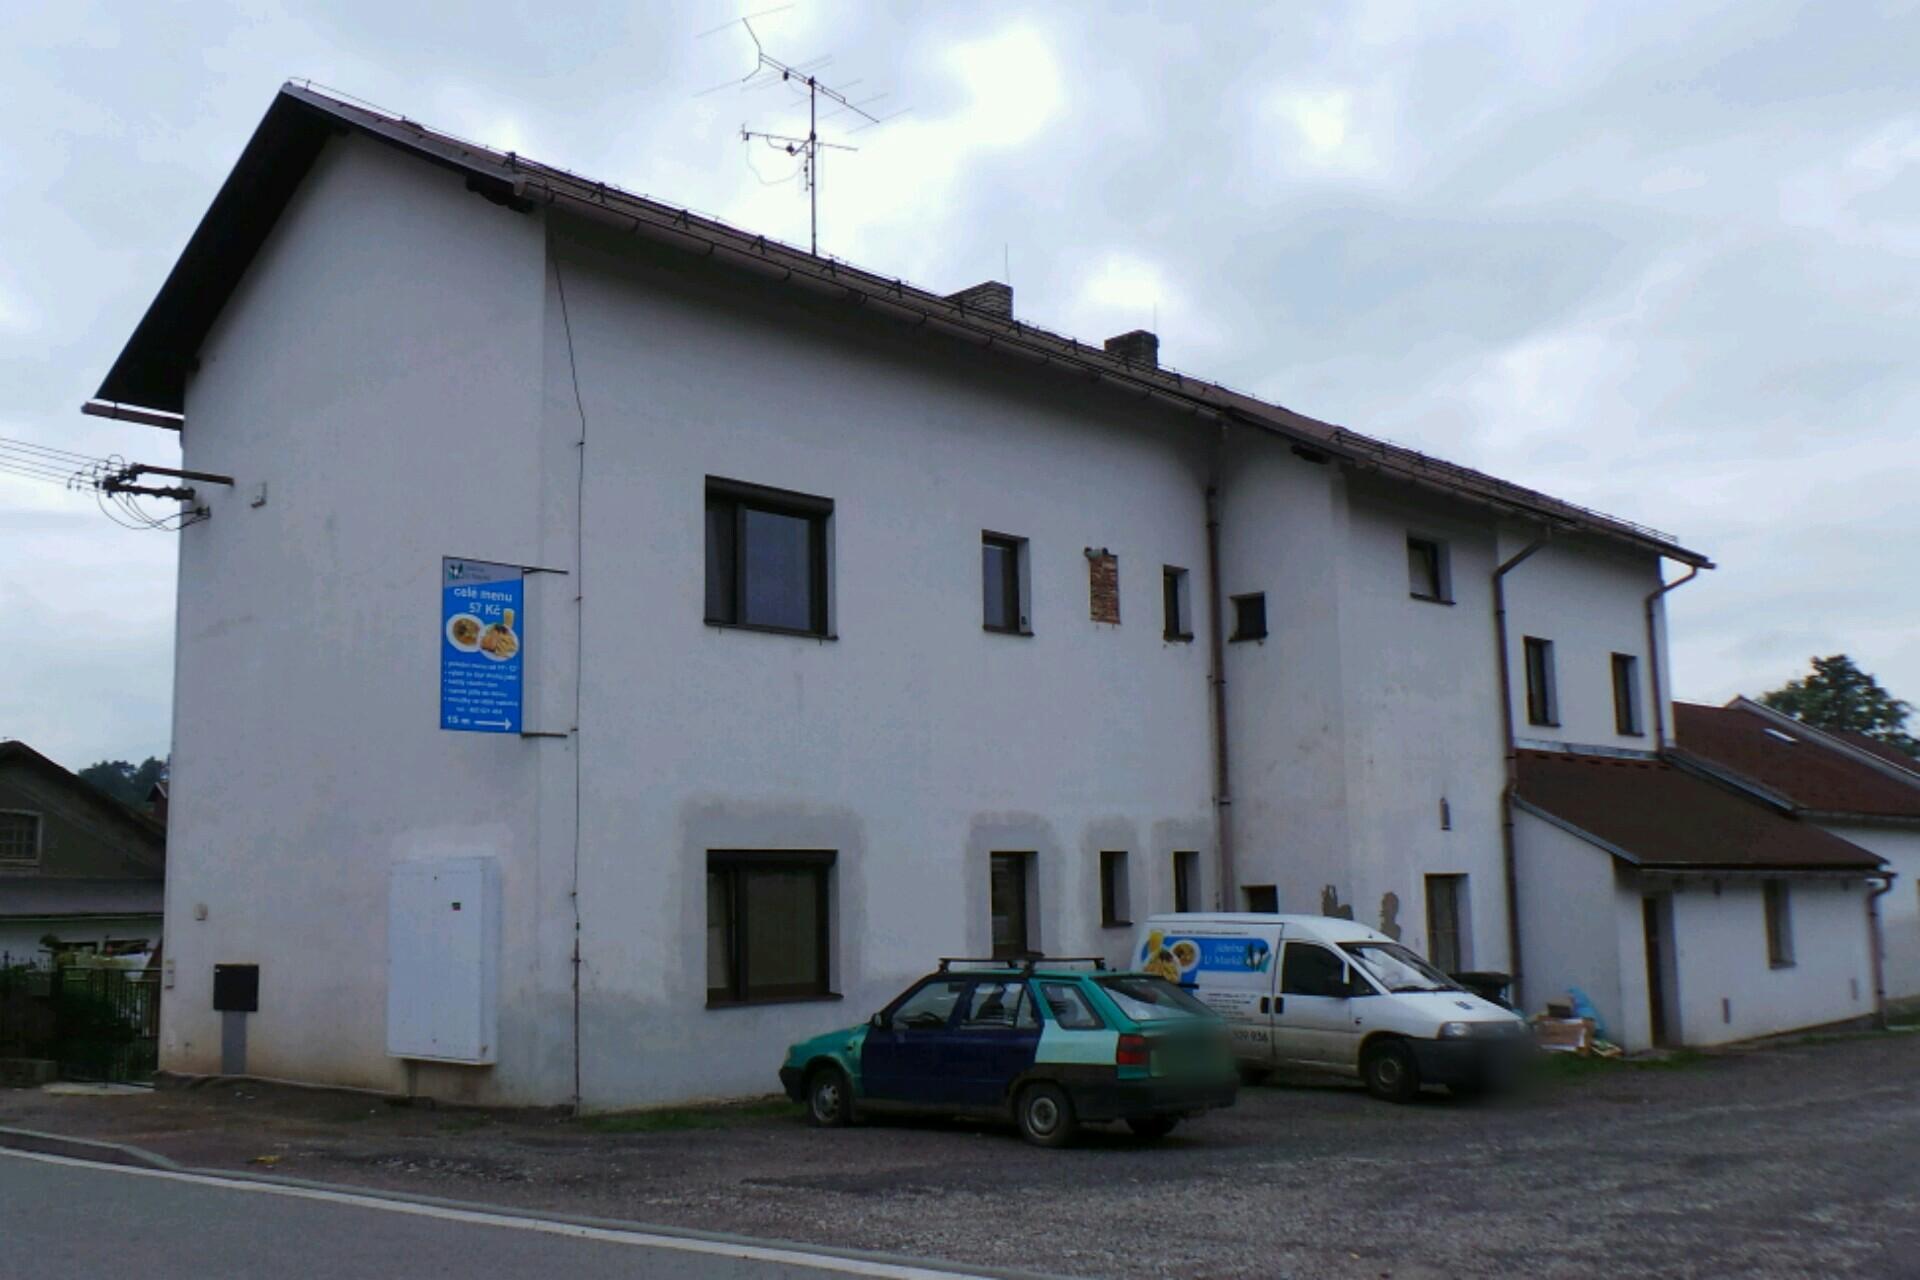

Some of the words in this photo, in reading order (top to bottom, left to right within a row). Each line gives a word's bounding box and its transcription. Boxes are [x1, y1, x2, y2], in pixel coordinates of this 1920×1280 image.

[480, 589, 513, 603] menu
[485, 603, 501, 616] Kč
[447, 715, 459, 724] 15
[1250, 1029, 1269, 1042] 936
